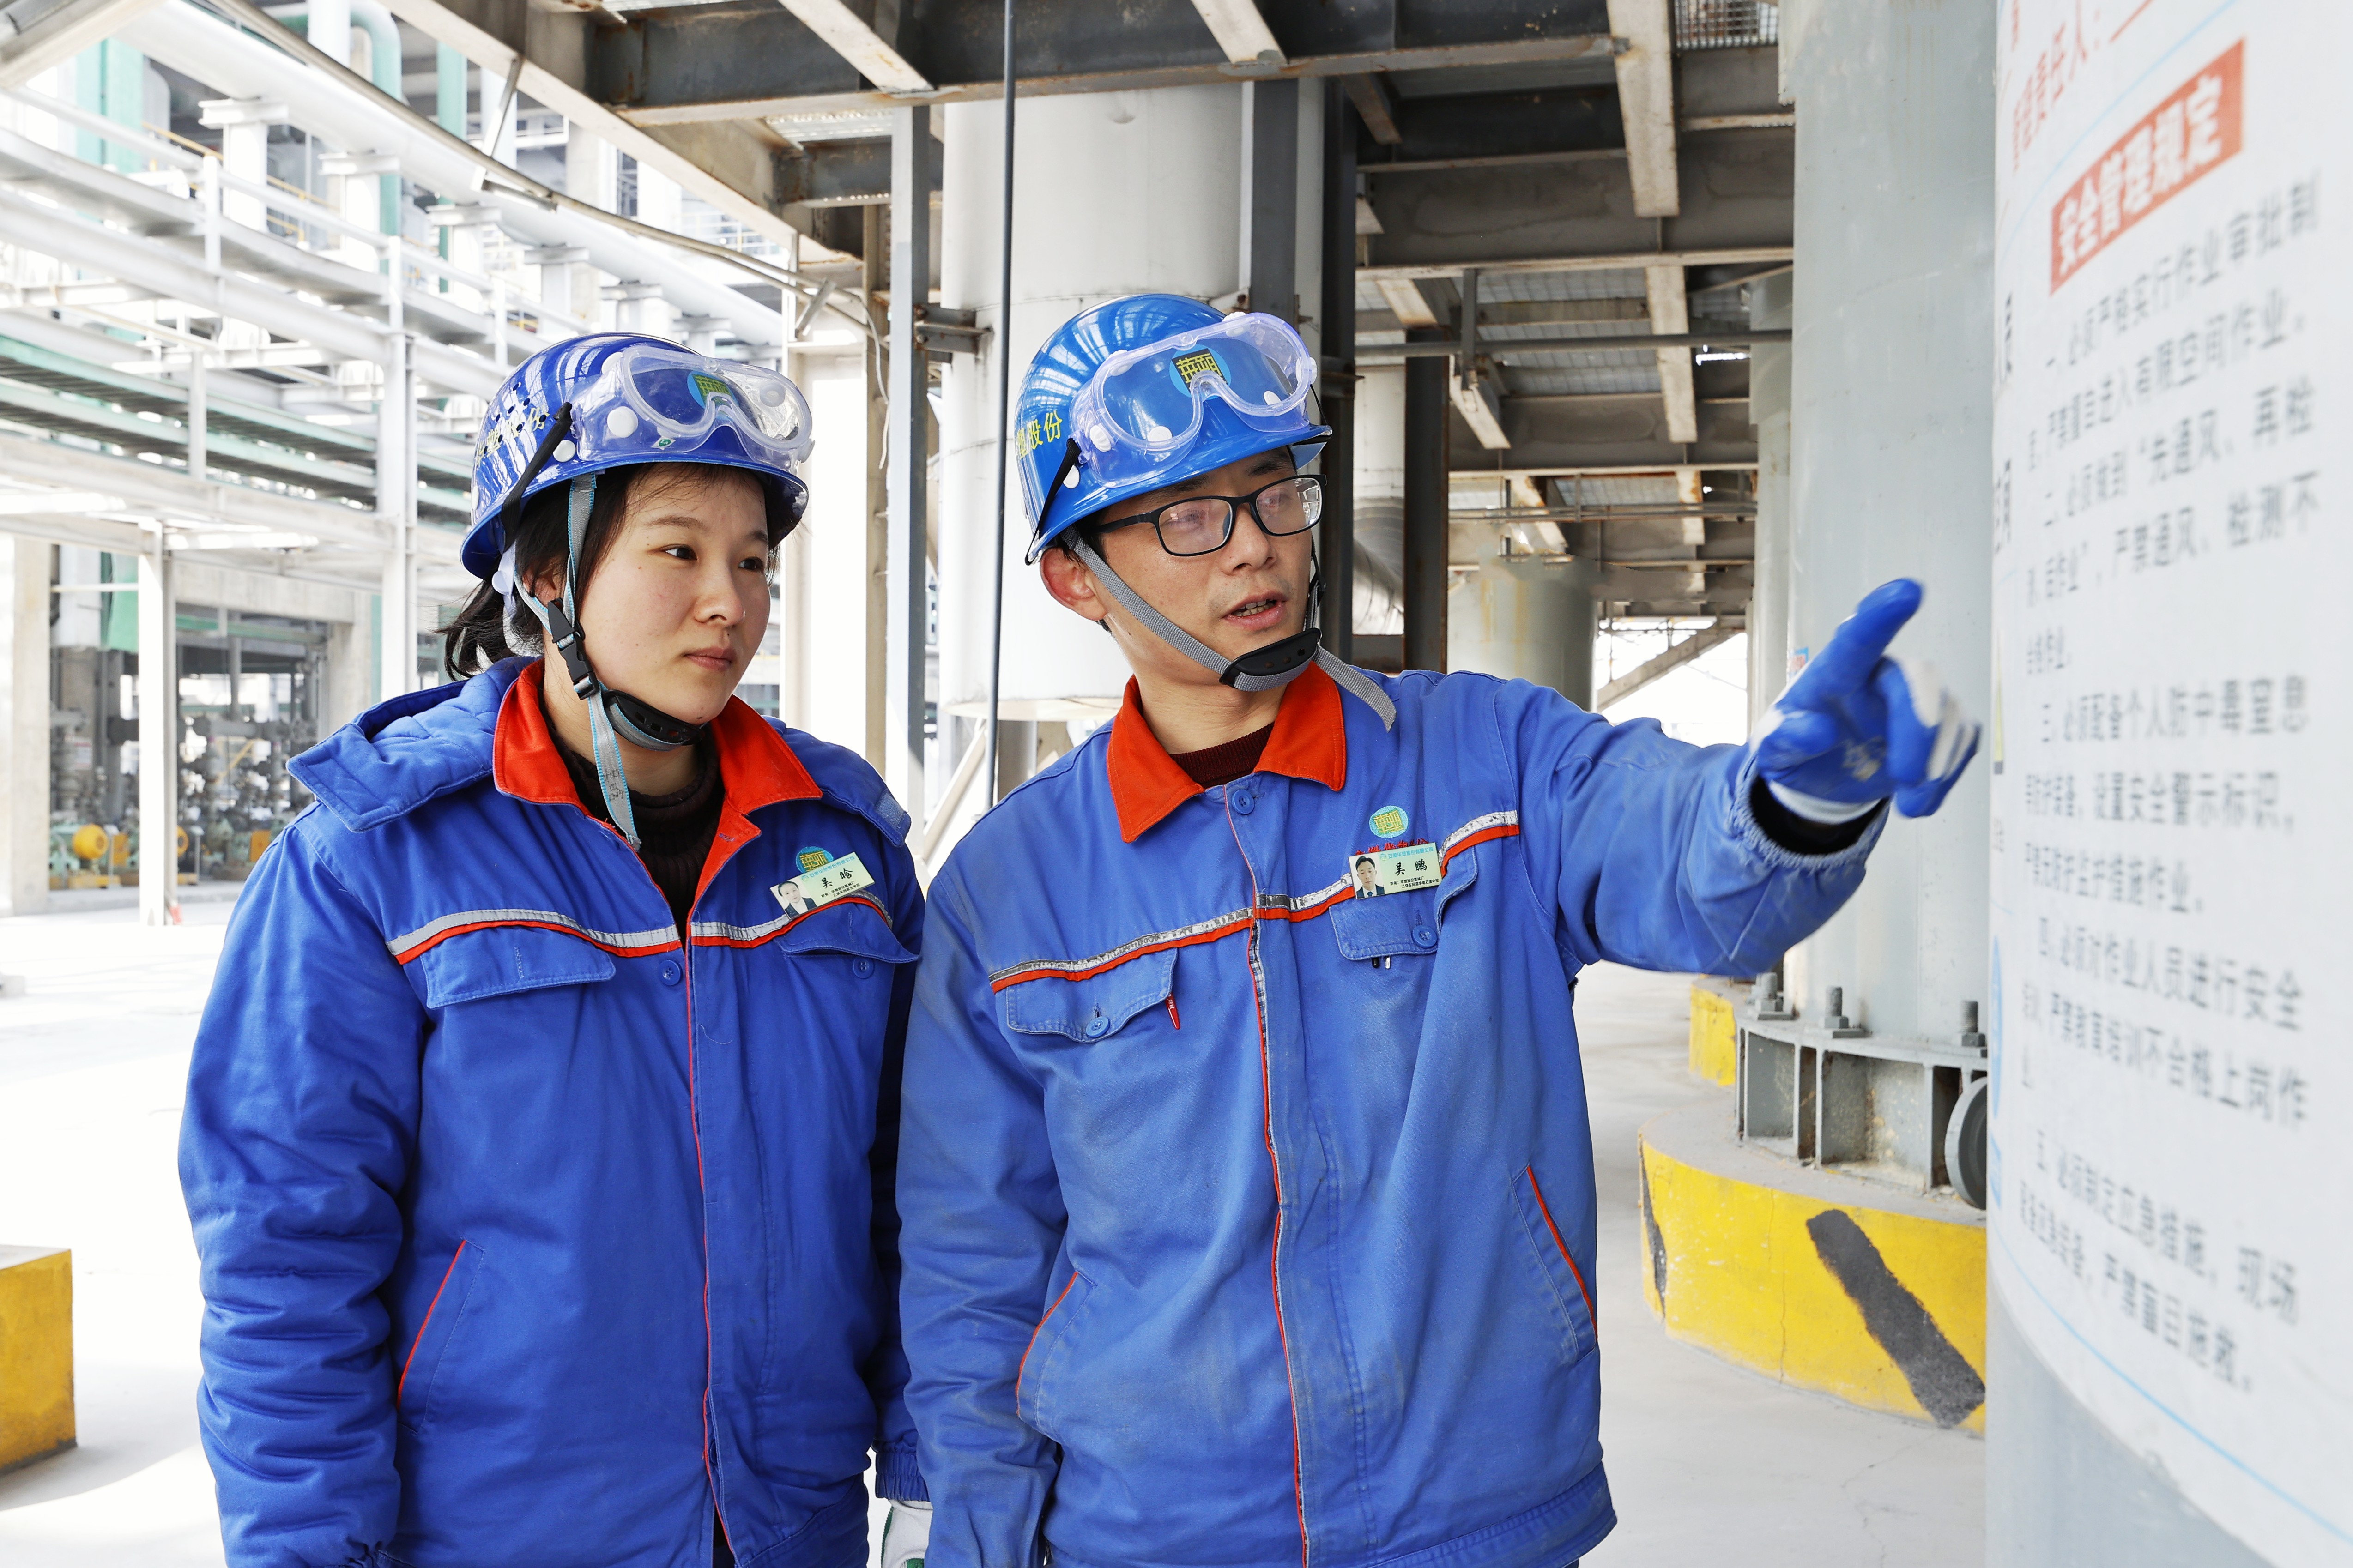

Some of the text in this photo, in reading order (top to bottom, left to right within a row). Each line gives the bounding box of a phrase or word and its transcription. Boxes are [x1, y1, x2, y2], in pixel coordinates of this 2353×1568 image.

[2058, 72, 2223, 277] 安全管理规定
